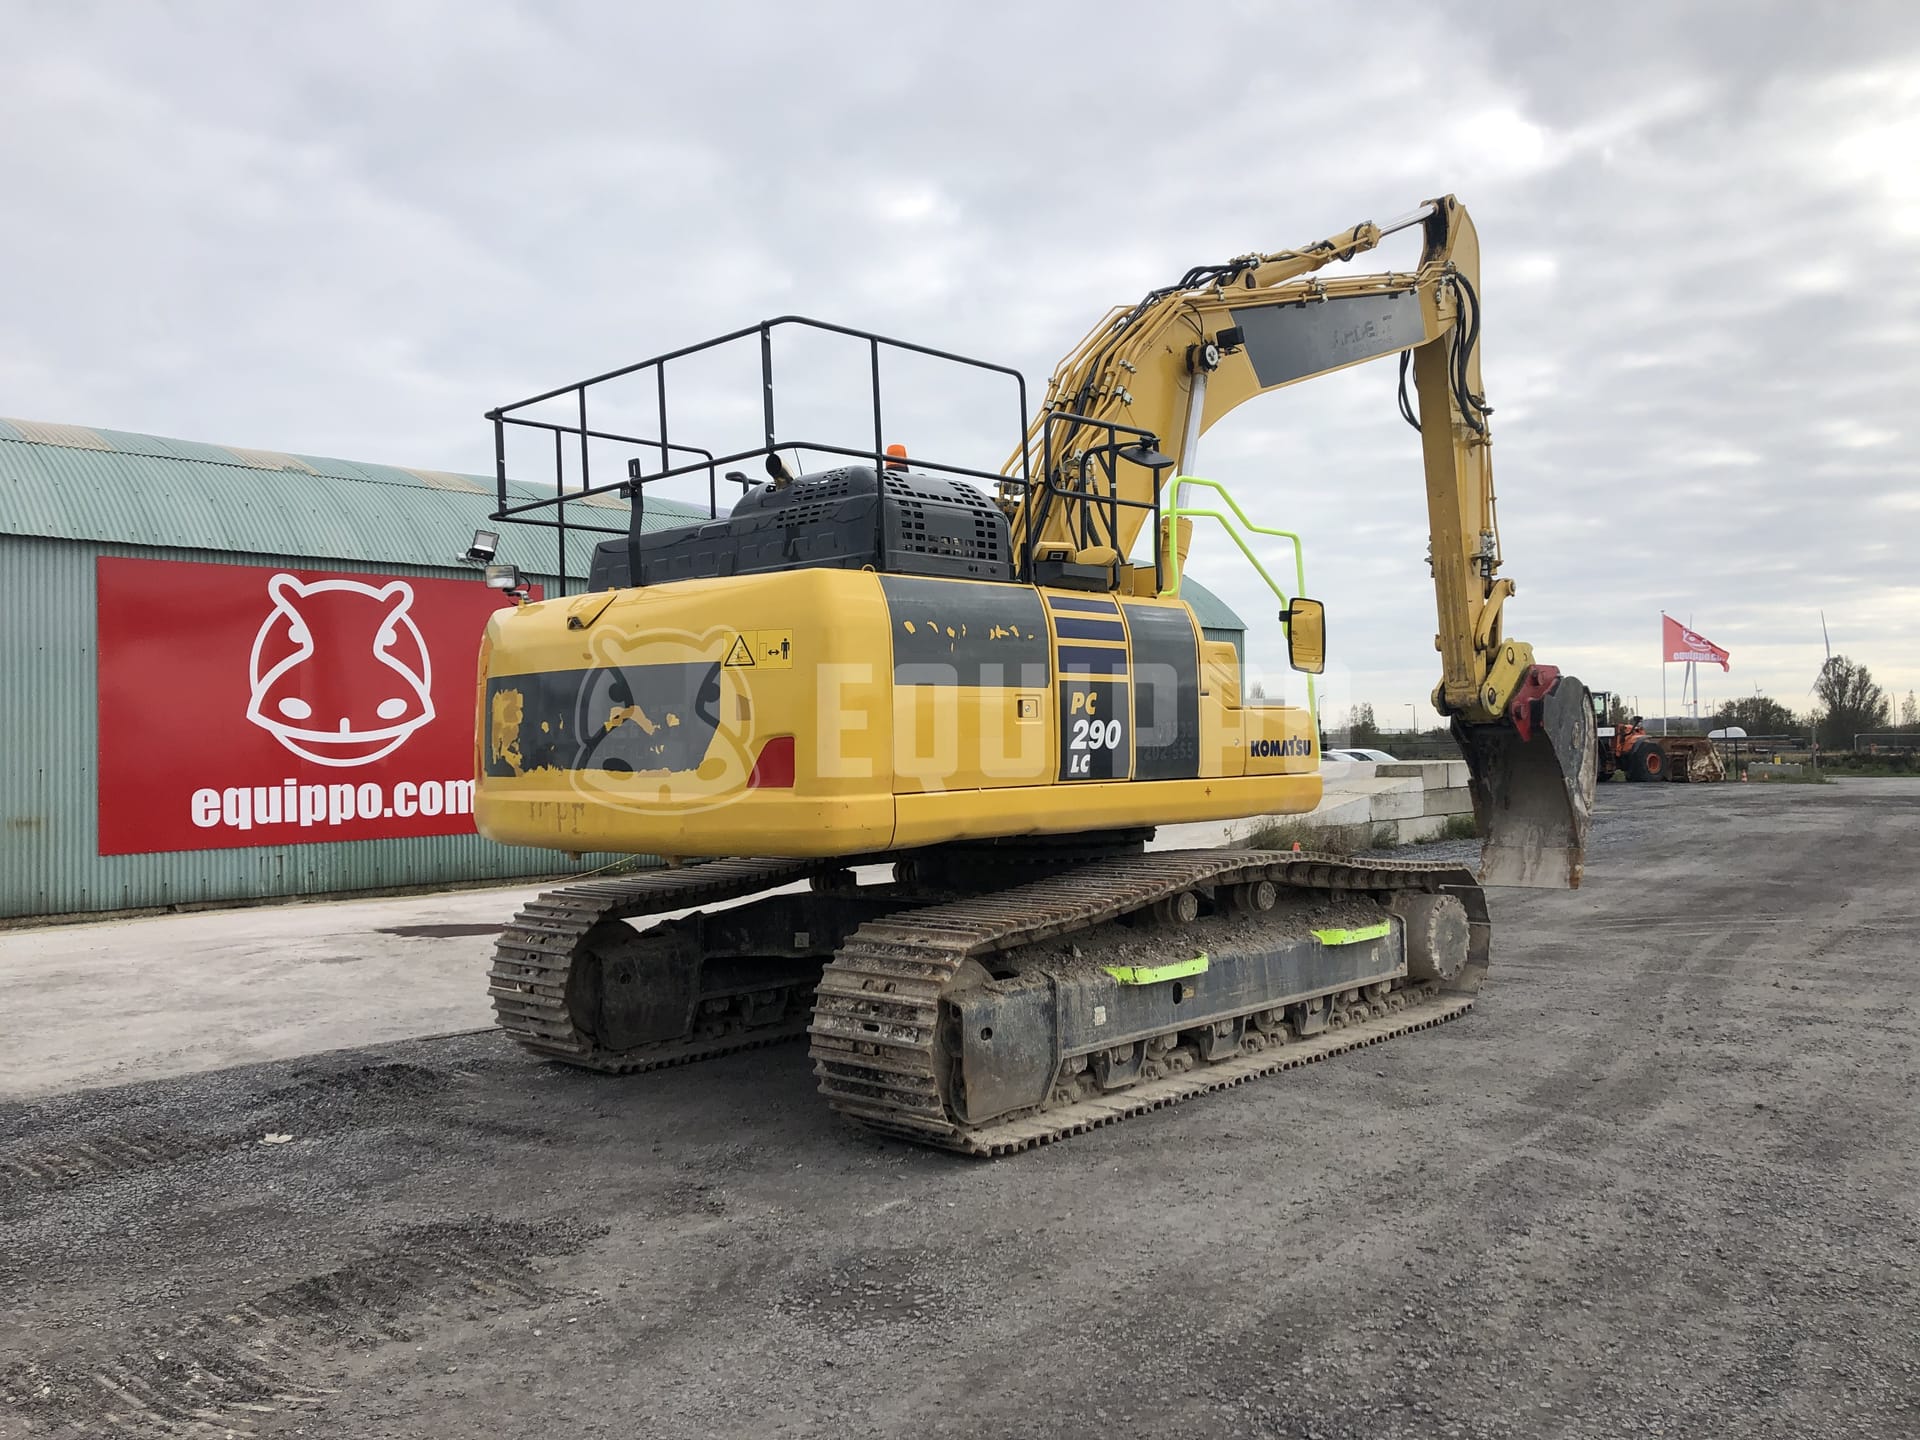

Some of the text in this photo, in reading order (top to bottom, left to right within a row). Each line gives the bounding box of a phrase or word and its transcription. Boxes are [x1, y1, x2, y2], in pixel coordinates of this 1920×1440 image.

[1071, 692, 1097, 715] PC
[1070, 719, 1122, 749] 290
[1251, 735, 1311, 757] KOMATSU
[1070, 754, 1091, 773] LC
[191, 778, 475, 829] equippo.com
